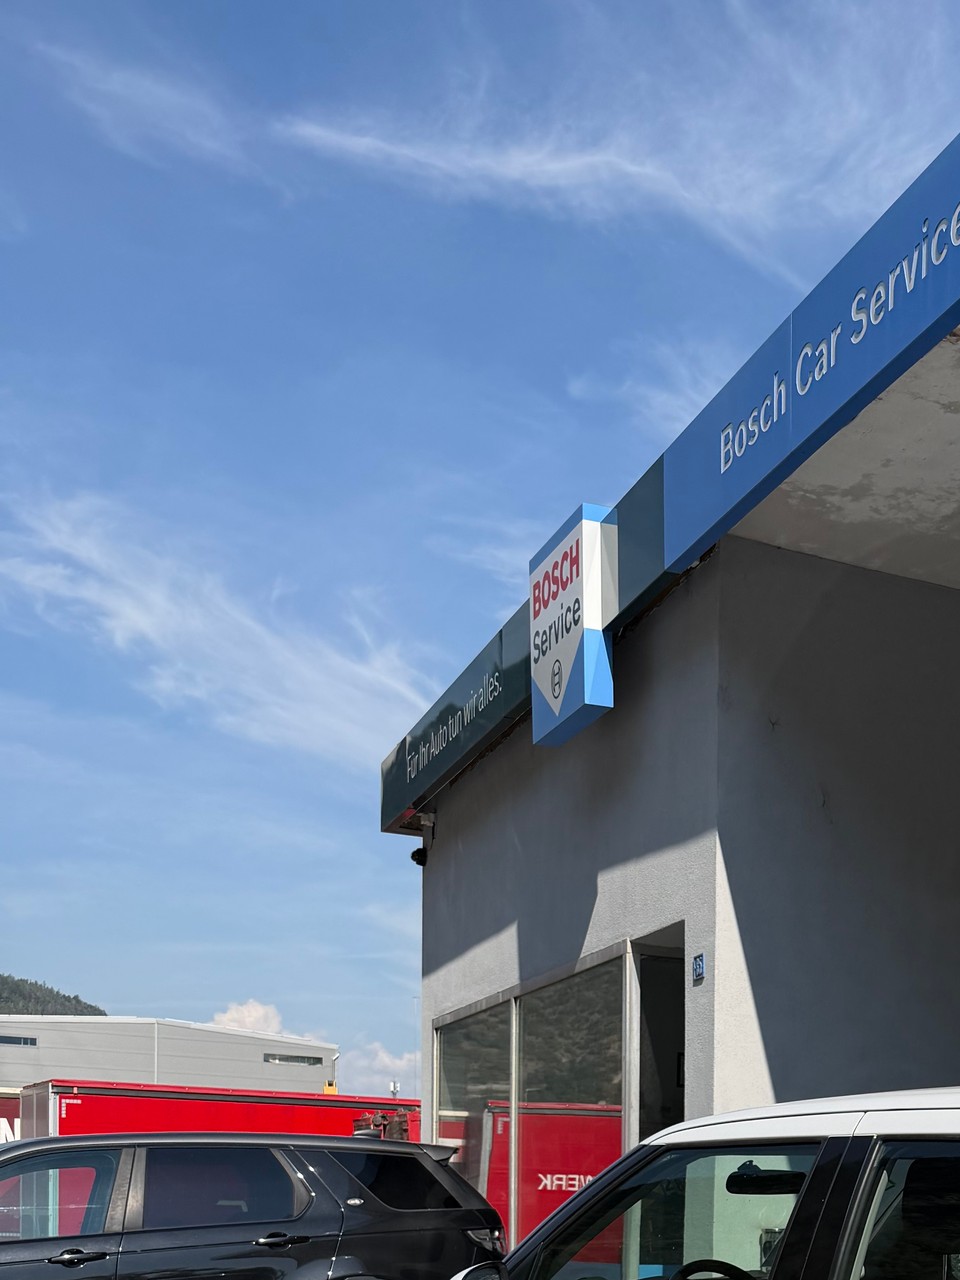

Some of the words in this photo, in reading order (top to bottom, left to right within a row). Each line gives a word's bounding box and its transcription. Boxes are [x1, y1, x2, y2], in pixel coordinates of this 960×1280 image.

[720, 371, 787, 474] Bosch
[795, 321, 842, 396] Car
[533, 538, 580, 620] BOSCH
[533, 596, 581, 664] Service
[406, 751, 418, 783] Für
[419, 741, 429, 771] Ihr
[430, 724, 447, 761] Auto
[448, 710, 462, 741] tun
[463, 690, 477, 726] wir
[478, 672, 502, 712] alles.
